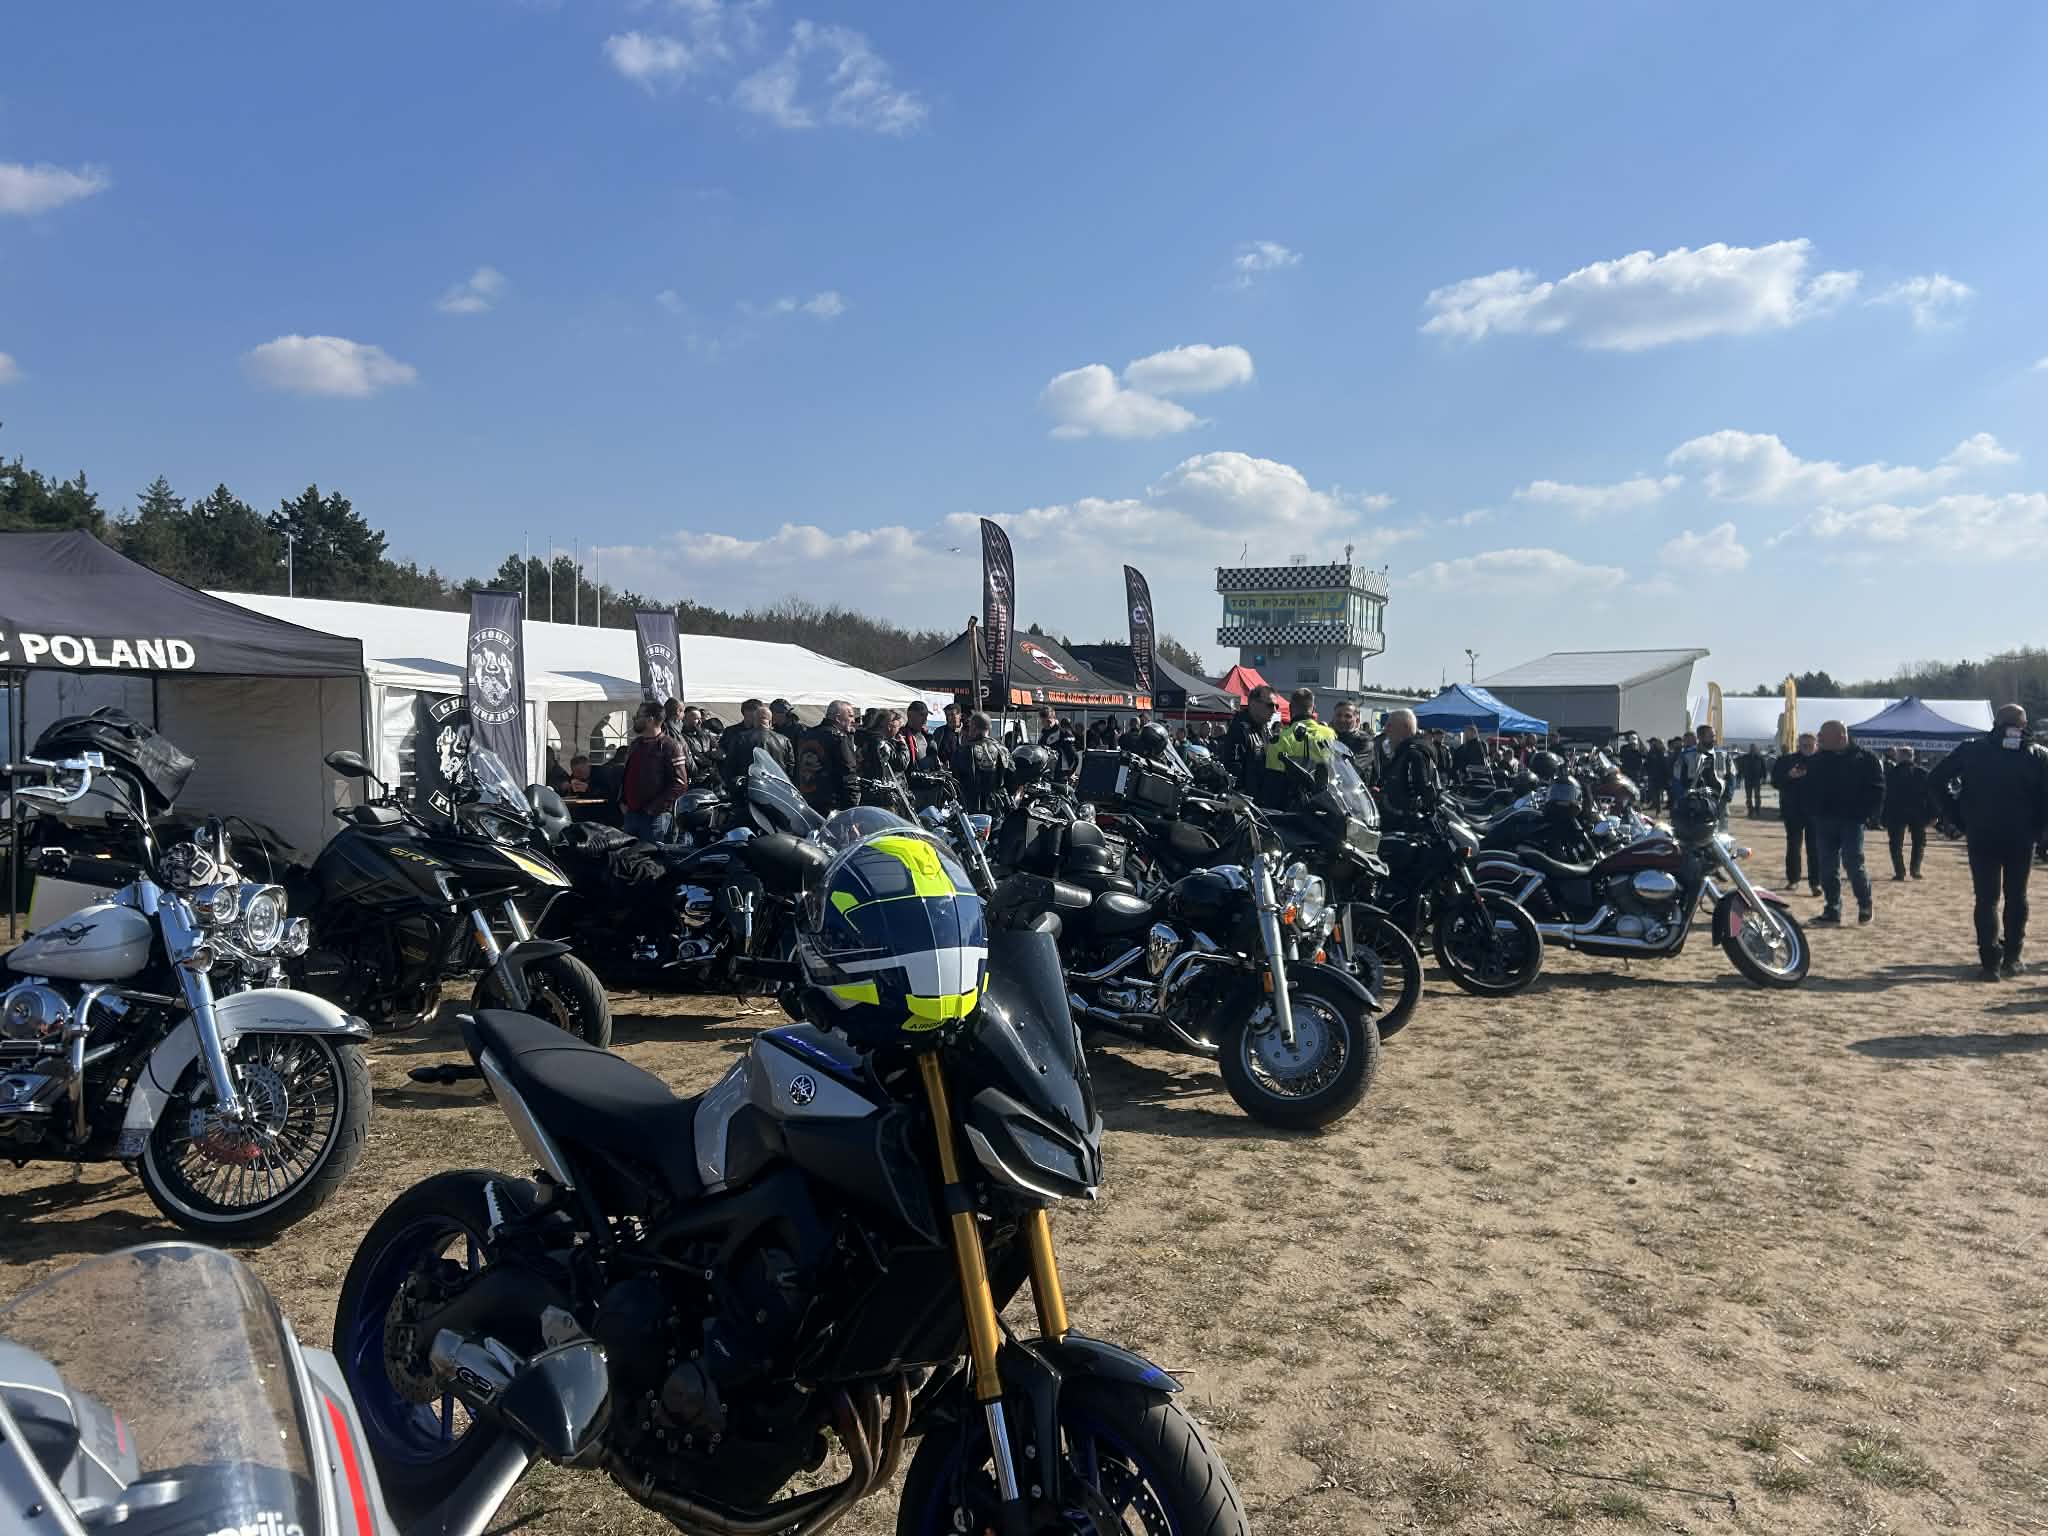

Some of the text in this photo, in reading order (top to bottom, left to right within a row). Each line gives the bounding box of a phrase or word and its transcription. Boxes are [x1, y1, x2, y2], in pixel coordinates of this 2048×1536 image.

[1232, 599, 1256, 608] TOR
[18, 633, 196, 670] POLAND
[390, 847, 443, 866] SRT
